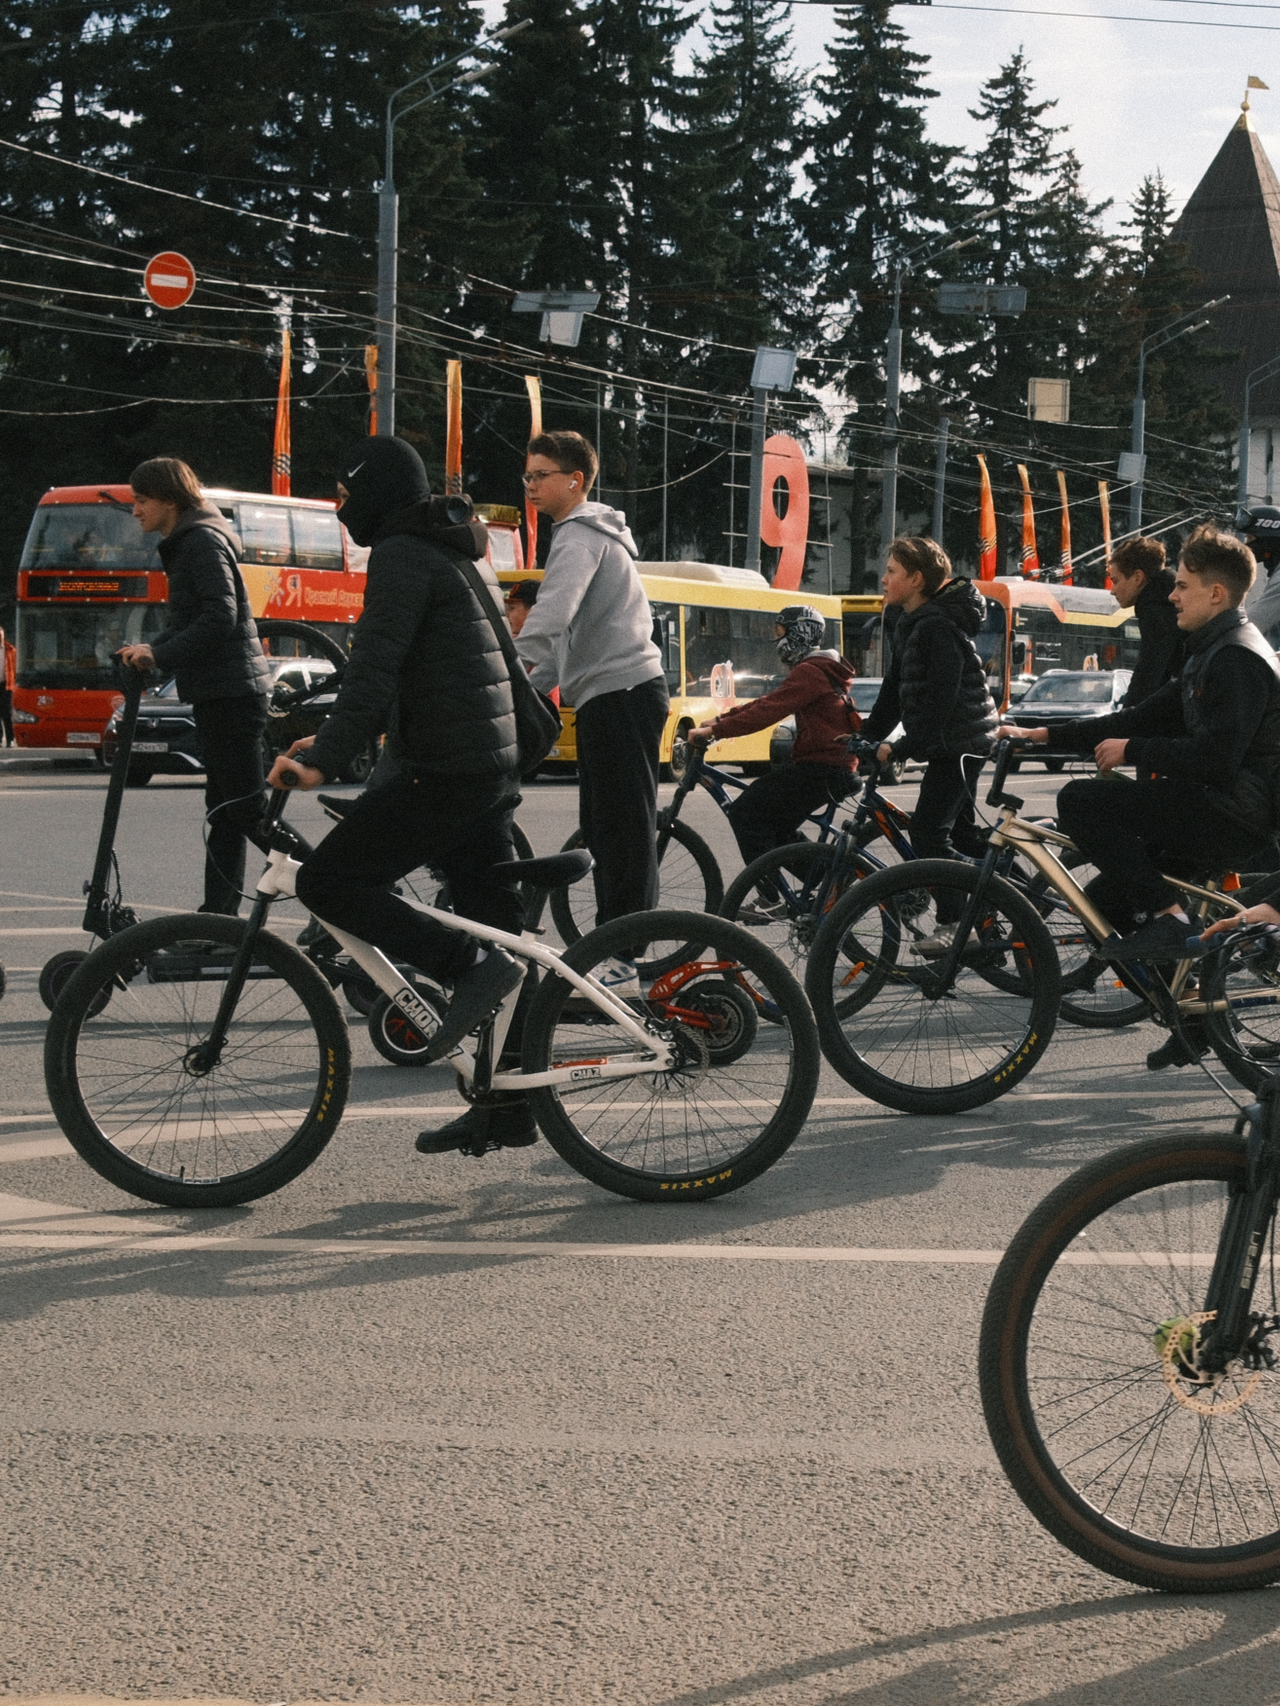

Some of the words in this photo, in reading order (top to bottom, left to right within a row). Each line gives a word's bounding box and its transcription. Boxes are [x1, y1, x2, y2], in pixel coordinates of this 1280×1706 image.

[761, 434, 810, 592] 9
[317, 1047, 335, 1122] MAXXIS
[994, 1031, 1038, 1083] MAXXIS
[660, 1169, 732, 1190] MAXXIS
